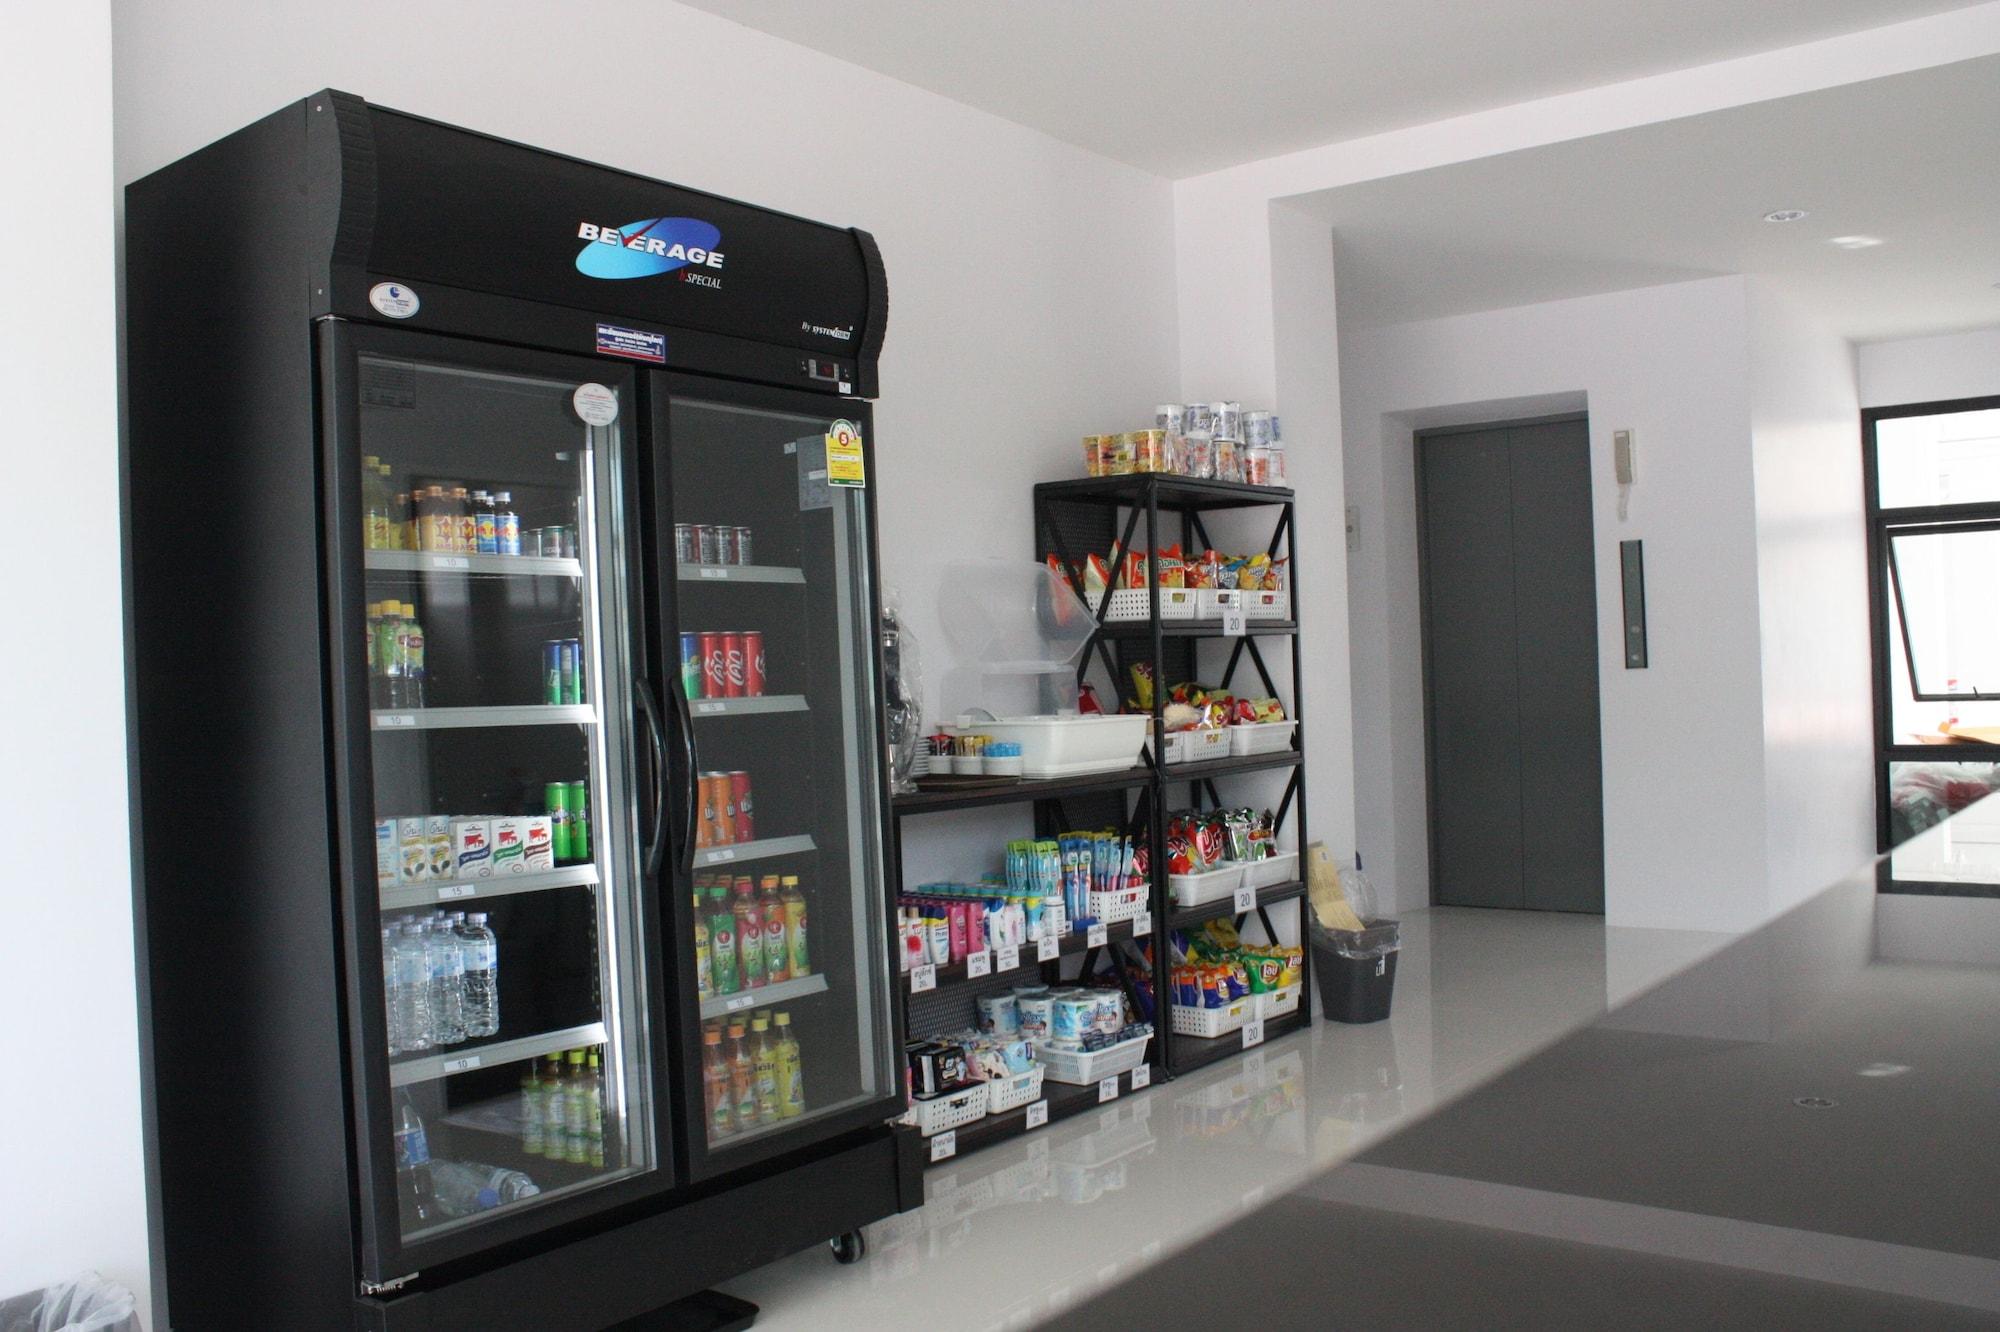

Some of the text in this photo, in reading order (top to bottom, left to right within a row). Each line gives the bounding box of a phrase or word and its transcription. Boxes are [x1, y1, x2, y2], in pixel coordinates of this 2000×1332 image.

[577, 221, 725, 269] BEVERAGE
[1230, 617, 1240, 631] 20
[1240, 893, 1251, 907] 20
[1248, 1026, 1258, 1041] 20
